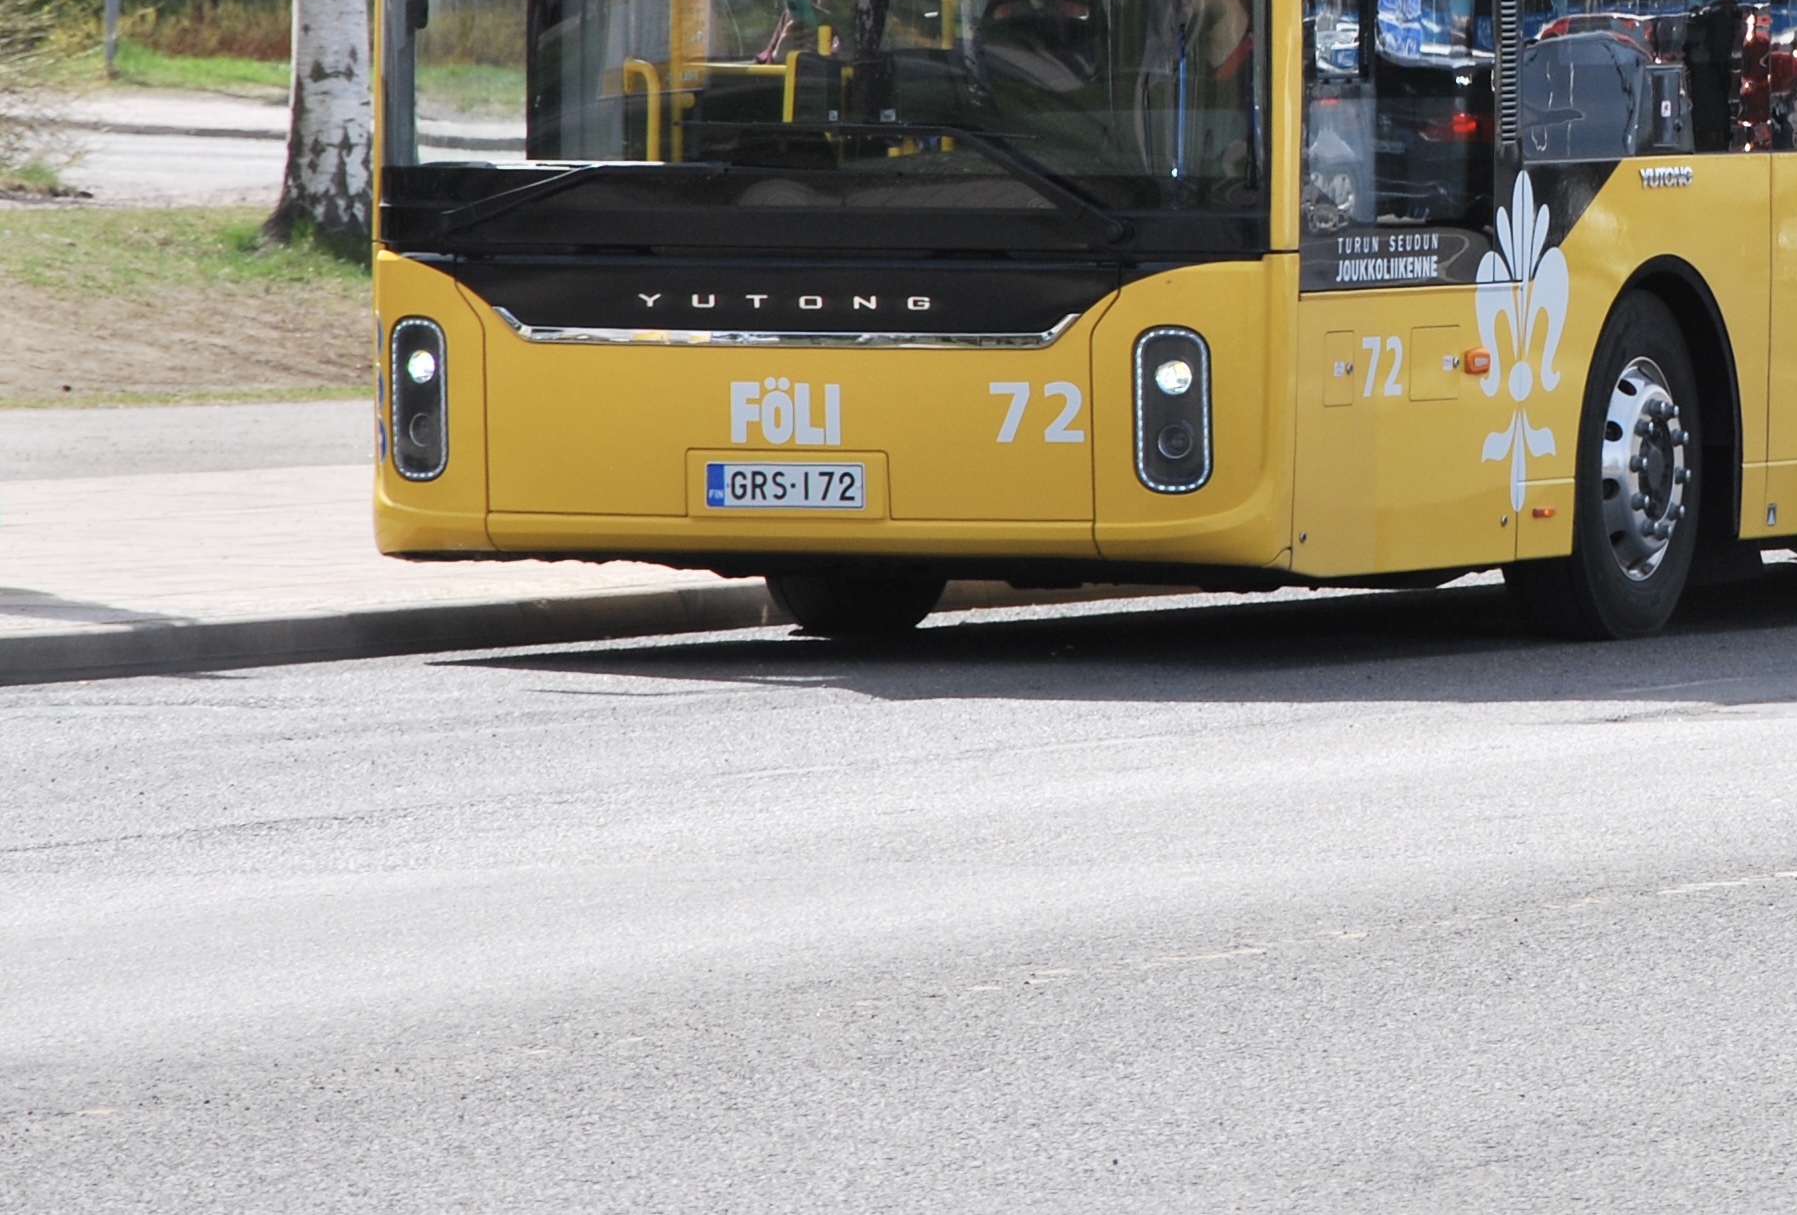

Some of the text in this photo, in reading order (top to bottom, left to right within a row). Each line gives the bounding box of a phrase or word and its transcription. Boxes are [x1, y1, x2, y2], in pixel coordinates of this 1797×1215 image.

[1639, 166, 1694, 189] YUTONG
[1337, 233, 1439, 254] TURUN SEUDUN
[1336, 255, 1438, 282] JOUKKOLIIKENNE
[638, 293, 931, 310] YUTONG
[1361, 336, 1403, 397] 72
[730, 376, 841, 446] FÖLI
[988, 381, 1086, 444] 72
